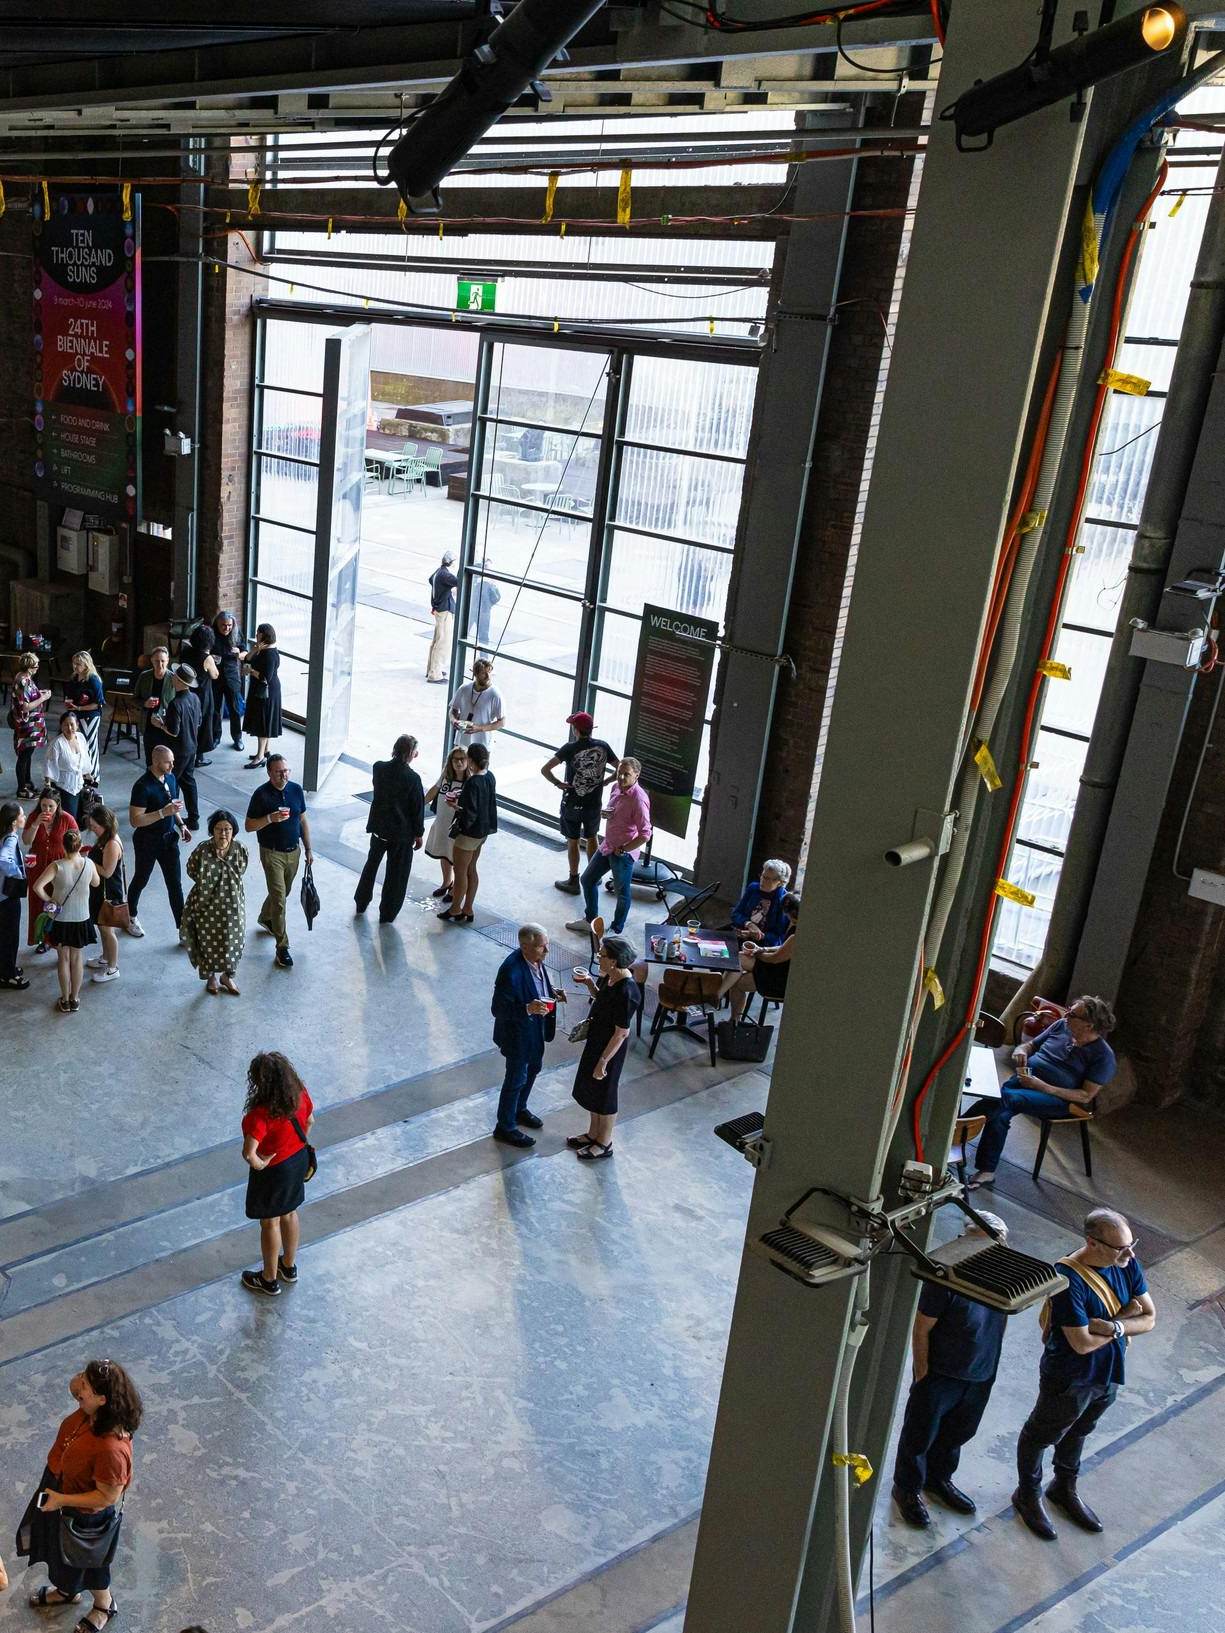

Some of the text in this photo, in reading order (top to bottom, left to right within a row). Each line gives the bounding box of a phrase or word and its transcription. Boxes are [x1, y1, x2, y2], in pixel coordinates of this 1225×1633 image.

[70, 229, 93, 247] TEN
[51, 247, 114, 267] THOUSAND
[67, 266, 98, 284] SUNS
[68, 318, 97, 337] 24TH
[57, 335, 110, 358] BIENNALE
[74, 354, 91, 372] OF
[62, 369, 105, 392] SYDNEY
[60, 415, 111, 432] FOOD AND DRINK
[60, 432, 97, 448] HOUSE STAGE
[60, 448, 96, 464] BATHROOMS
[61, 465, 71, 475] LIFT
[60, 482, 119, 504] PROGRAMMING HUB
[650, 614, 708, 640] WELCOME
